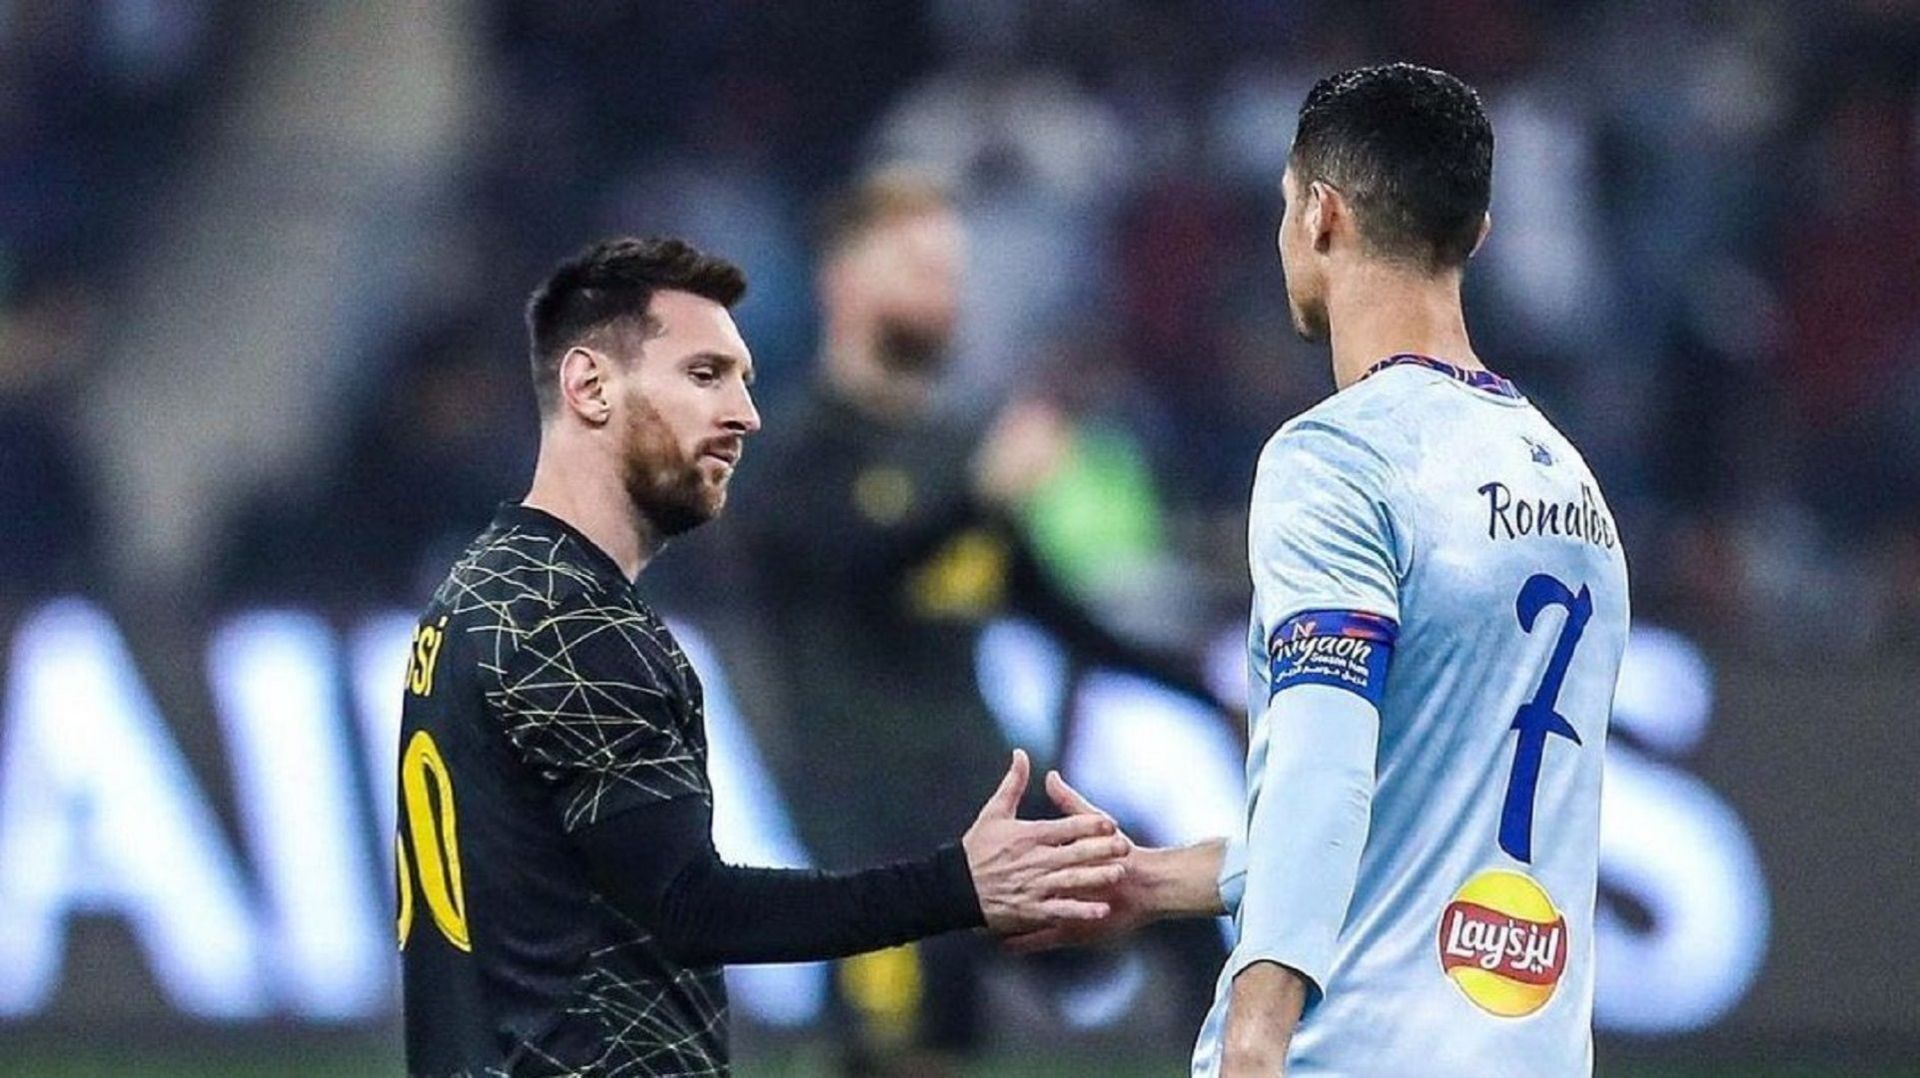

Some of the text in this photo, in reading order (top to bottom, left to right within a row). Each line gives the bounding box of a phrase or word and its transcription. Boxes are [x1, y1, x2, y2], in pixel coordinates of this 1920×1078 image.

[1477, 481, 1615, 549] Ronaldo
[1497, 572, 1594, 866] 7
[1446, 909, 1526, 970] Lay's
